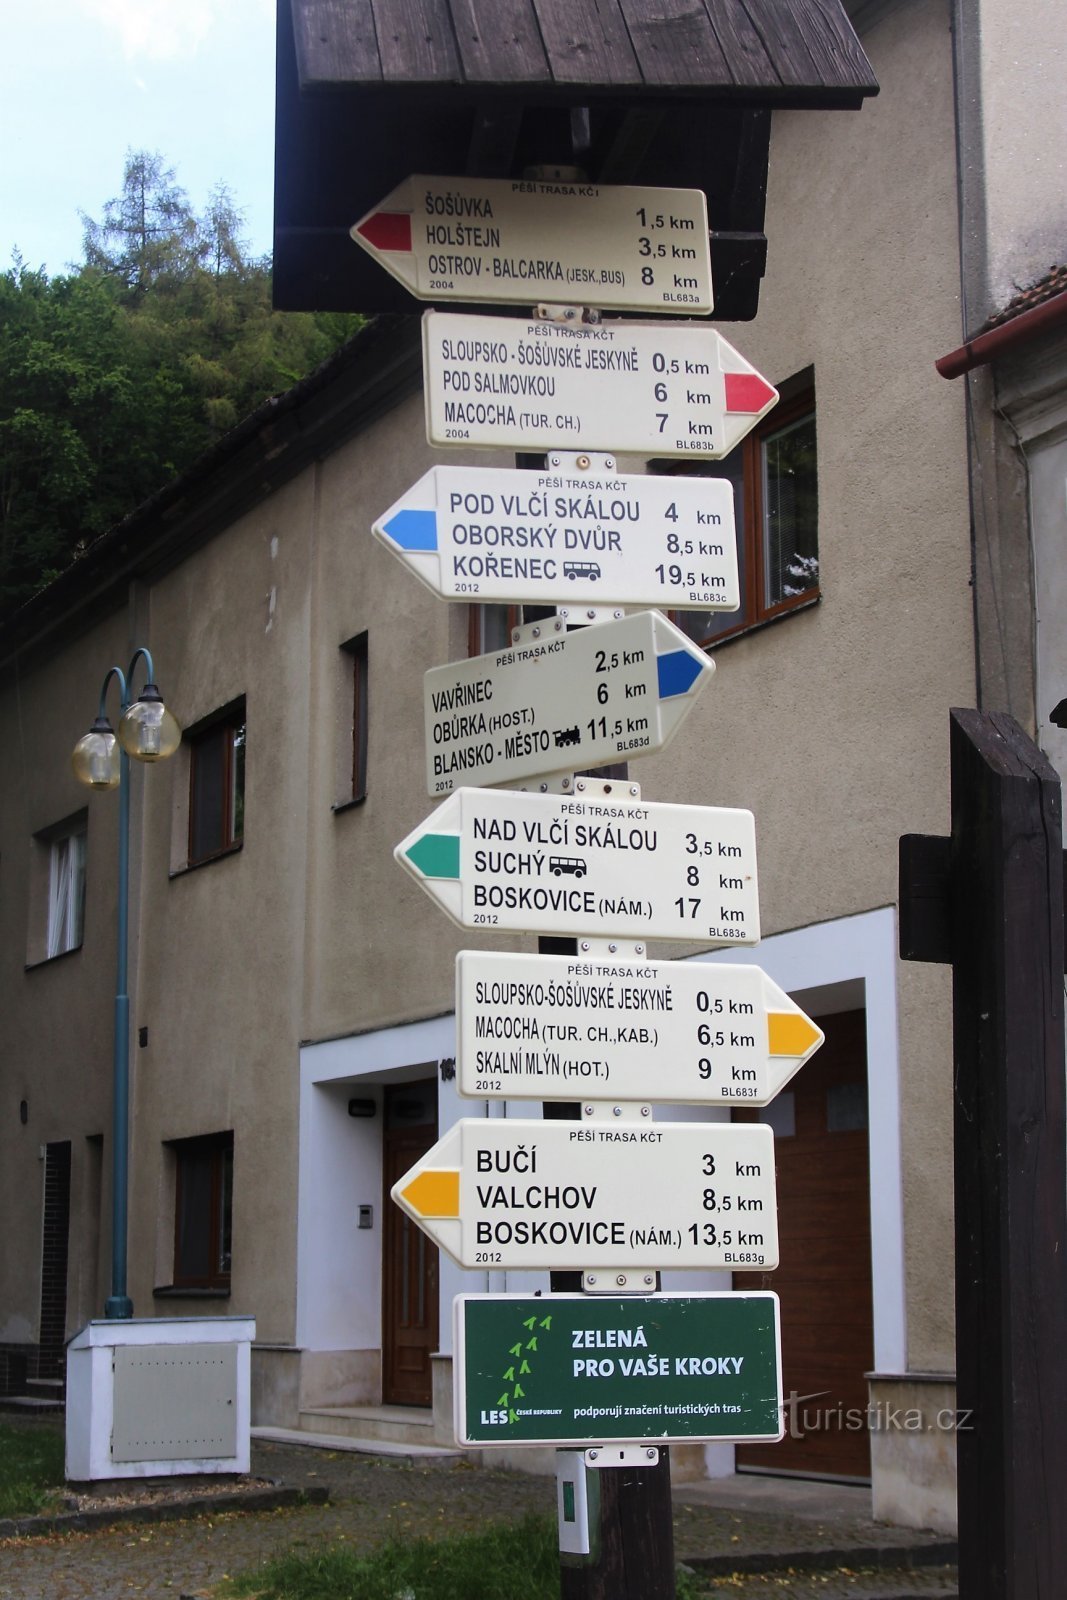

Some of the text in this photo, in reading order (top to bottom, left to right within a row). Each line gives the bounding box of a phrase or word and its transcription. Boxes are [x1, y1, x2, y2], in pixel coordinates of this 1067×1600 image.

[539, 184, 576, 195] TRASA
[636, 208, 664, 229] 1,5
[670, 216, 694, 229] km
[426, 224, 695, 258] HOLŠTEJN 3,5 km
[429, 255, 481, 275] OSTROV
[493, 258, 563, 280] BALCARKA
[642, 267, 654, 285] 8
[674, 275, 697, 288] km
[430, 280, 453, 289] 2004
[663, 293, 699, 302] BL683a
[554, 328, 590, 339] TRASA
[592, 328, 615, 342] KČT
[442, 340, 507, 363] SLOUPSKO
[585, 347, 638, 371] JESKYNĚ
[653, 353, 679, 375] 0,5
[685, 361, 709, 374] km
[444, 371, 710, 404] POD SALMOVKOU 6 km
[445, 402, 712, 434] MACOCHA (TUR. CH.) 7 km
[446, 429, 469, 438] 2004
[676, 440, 713, 450] BL683b
[566, 480, 602, 490] TRASA
[606, 481, 627, 491] KČT
[451, 492, 720, 524] POD VLČÍ SKÁLOU 4 km
[453, 523, 723, 556] OBORSKÝ DVŮR 8,5 km
[454, 552, 725, 587] KOŘENEC 19,5 km
[455, 584, 479, 592] 2012
[690, 593, 726, 602] BL683c
[517, 647, 546, 659] TRASA
[548, 641, 565, 653] KČT
[432, 651, 644, 713] VAVŘINEC 2,5 km
[434, 683, 646, 744] OBŮRKA (HOST.) 6 km
[434, 743, 493, 775] BLANSKO
[505, 730, 549, 759] MĚSTO
[588, 717, 622, 740] 11,5
[627, 718, 648, 732] km
[617, 736, 649, 751] BL683d
[436, 780, 453, 791] 2012
[588, 807, 624, 817] TRASA
[628, 809, 648, 819] KČT
[474, 818, 741, 857] NAD VLČÍ SKÁLOU 3,5 km
[475, 850, 742, 889] SUCHÝ 8 km
[475, 885, 744, 921] BOSKOVICE (NÁM.) 17 km
[474, 914, 498, 924] 2012
[709, 928, 745, 938] BL683e
[596, 967, 633, 977] TRASA
[637, 968, 658, 978] KČT
[618, 985, 672, 1010] JESKYNĚ
[697, 991, 723, 1014] 0,5
[729, 1000, 753, 1014] km
[476, 1016, 754, 1047] MACOCHA (TUR. CH.,KAB.) 6,5 km
[477, 1047, 756, 1080] SKALNÍ MLÝN (HOT.) 9 km
[476, 1081, 501, 1090] 2012
[722, 1087, 757, 1096] BL683f
[599, 1133, 637, 1142] TRASA
[641, 1132, 662, 1142] KČT
[478, 1145, 760, 1176] BUČÍ 3 km
[477, 1186, 762, 1213] VALCHOV 8,5 km
[477, 1222, 763, 1249] BOSKOVICE (NÁM.) 13,5 km
[476, 1253, 501, 1262] 2012
[725, 1253, 764, 1264] BL683g
[572, 1326, 647, 1348] ZELENÁ
[574, 1354, 743, 1377] PRO VAŠE KROKY
[574, 1404, 741, 1419] podporují značení turistických tras
